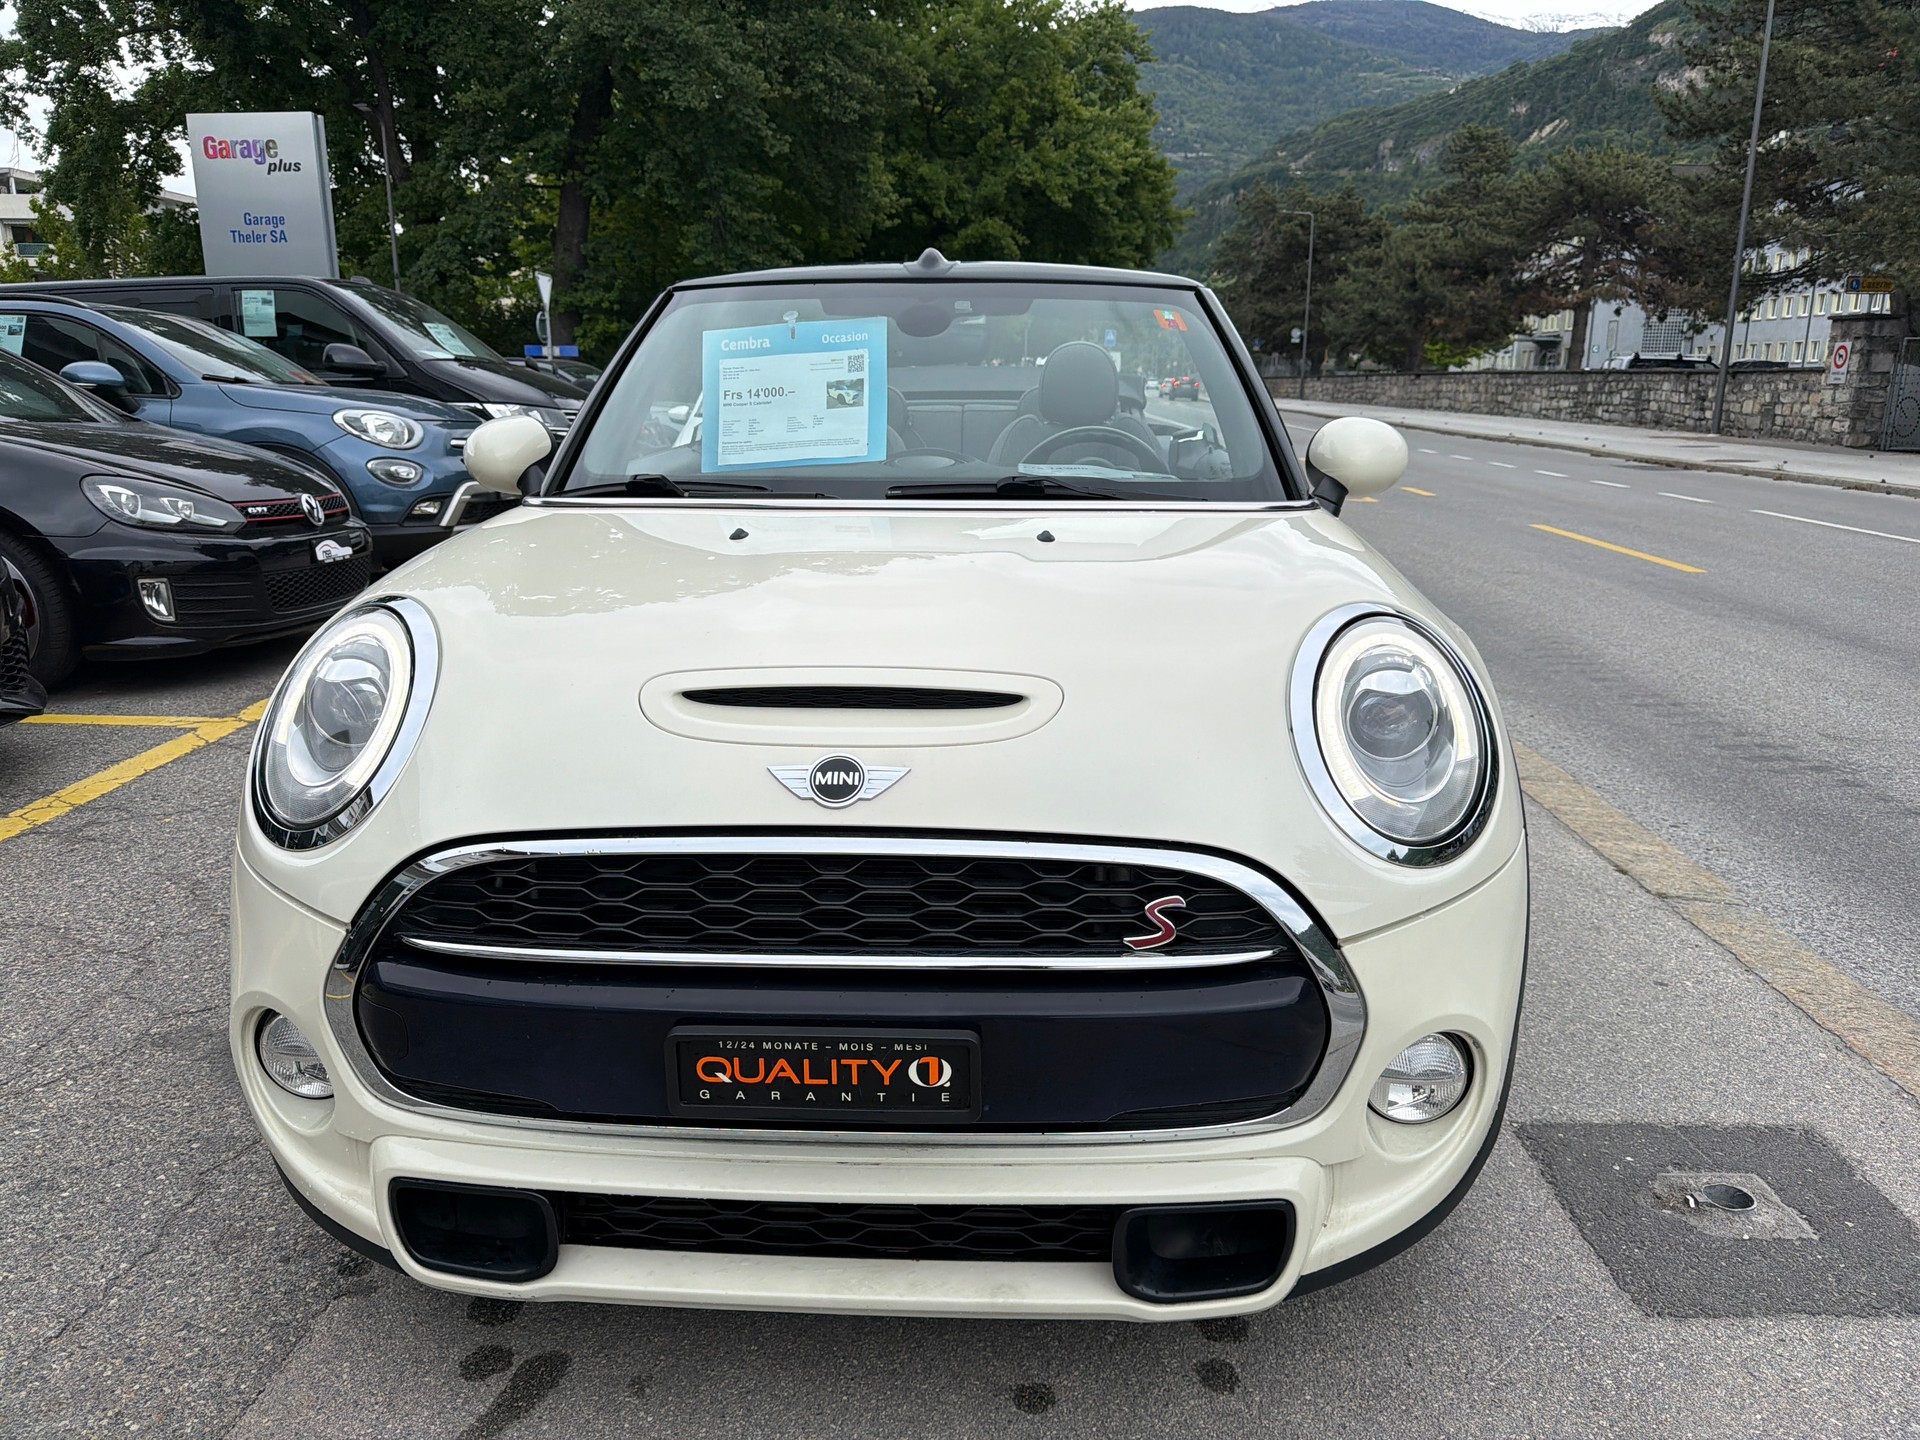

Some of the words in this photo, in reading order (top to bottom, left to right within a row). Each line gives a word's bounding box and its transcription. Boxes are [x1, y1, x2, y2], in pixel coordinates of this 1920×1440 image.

[203, 136, 279, 165] Garage
[266, 158, 302, 175] plus
[243, 212, 286, 229] Garage
[229, 230, 267, 243] Theler
[270, 229, 288, 243] SA
[720, 336, 771, 351] Cembra
[821, 331, 869, 344] Occasion
[723, 389, 743, 400] Frs
[815, 771, 860, 786] MINI
[1122, 895, 1187, 951] S
[718, 1040, 756, 1049] 12/24
[762, 1041, 819, 1051] MONATE
[838, 1042, 874, 1051] MOIS
[894, 1043, 928, 1051] MESI
[696, 1056, 903, 1086] QUALITY
[699, 1089, 950, 1103] GARANTIE
